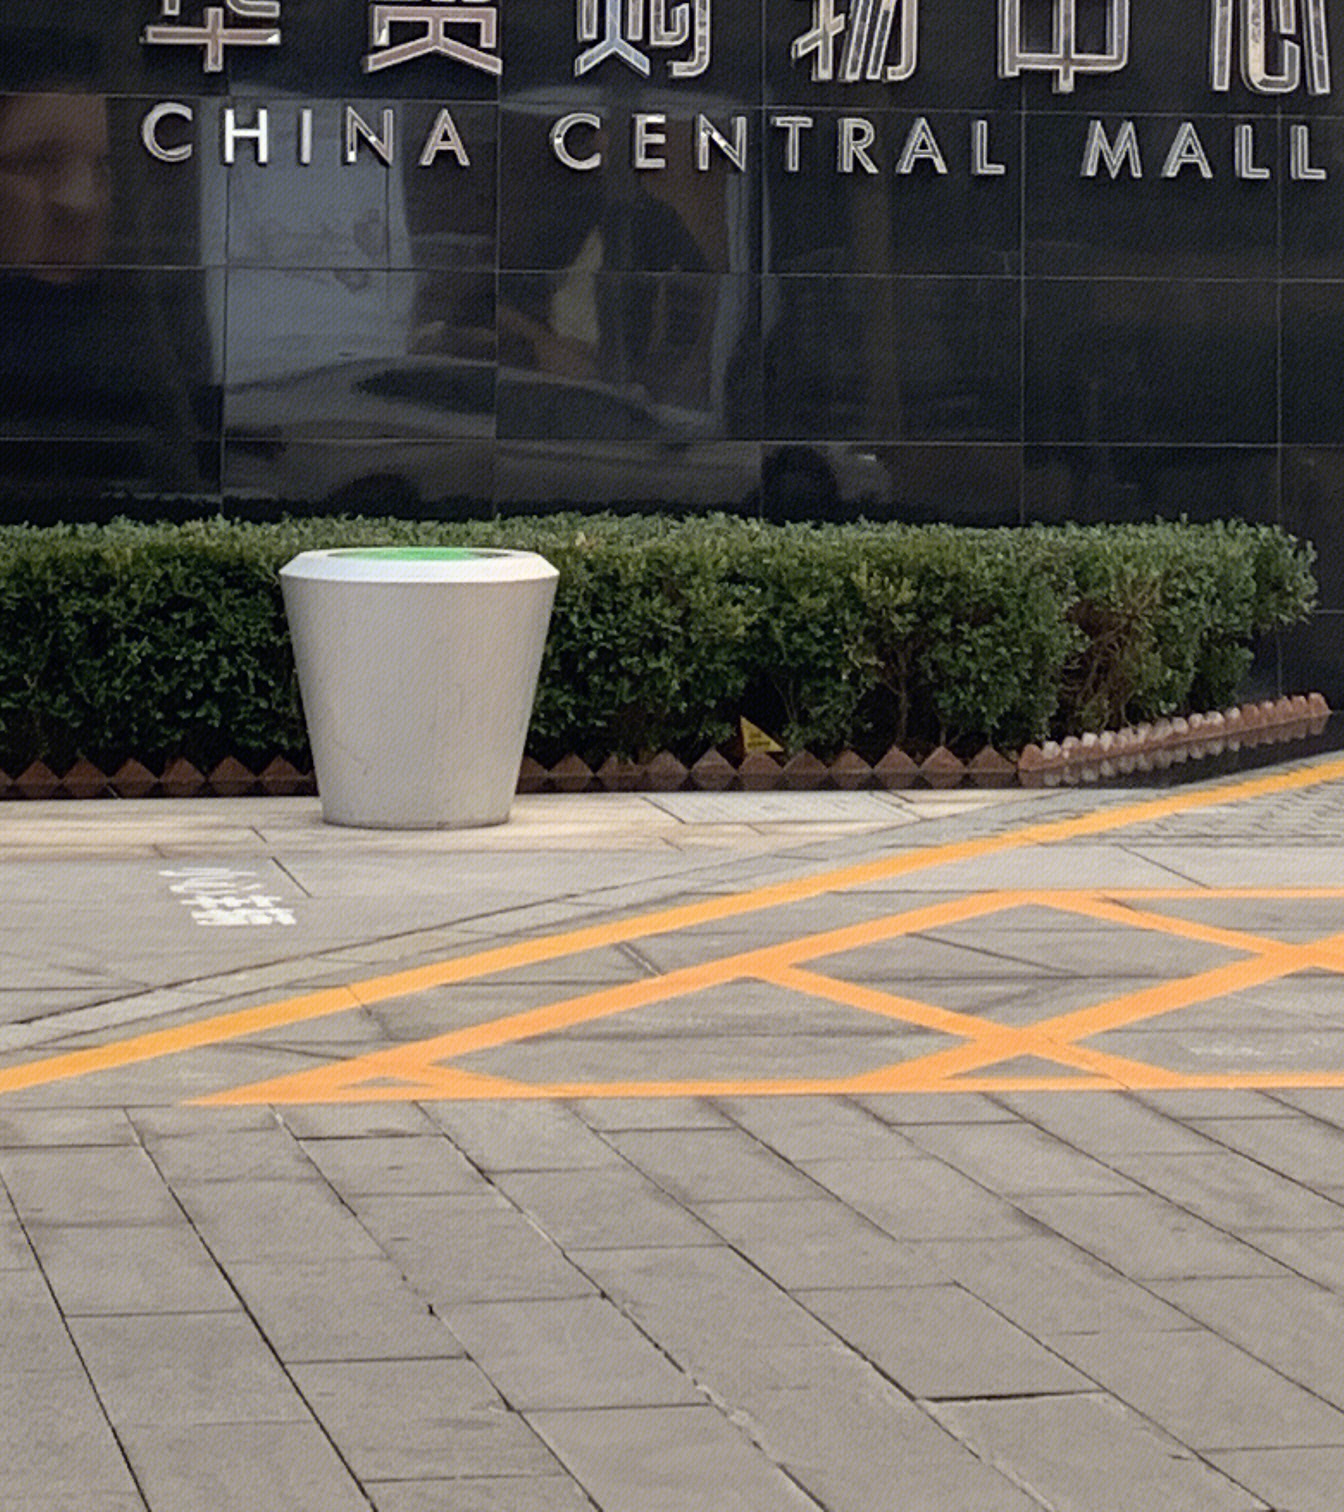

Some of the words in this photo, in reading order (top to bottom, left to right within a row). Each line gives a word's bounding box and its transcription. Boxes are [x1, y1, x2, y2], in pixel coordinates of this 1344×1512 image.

[142, 101, 471, 167] CHINA
[549, 112, 1006, 176] CENTRAL
[1080, 120, 1328, 180] MALL
